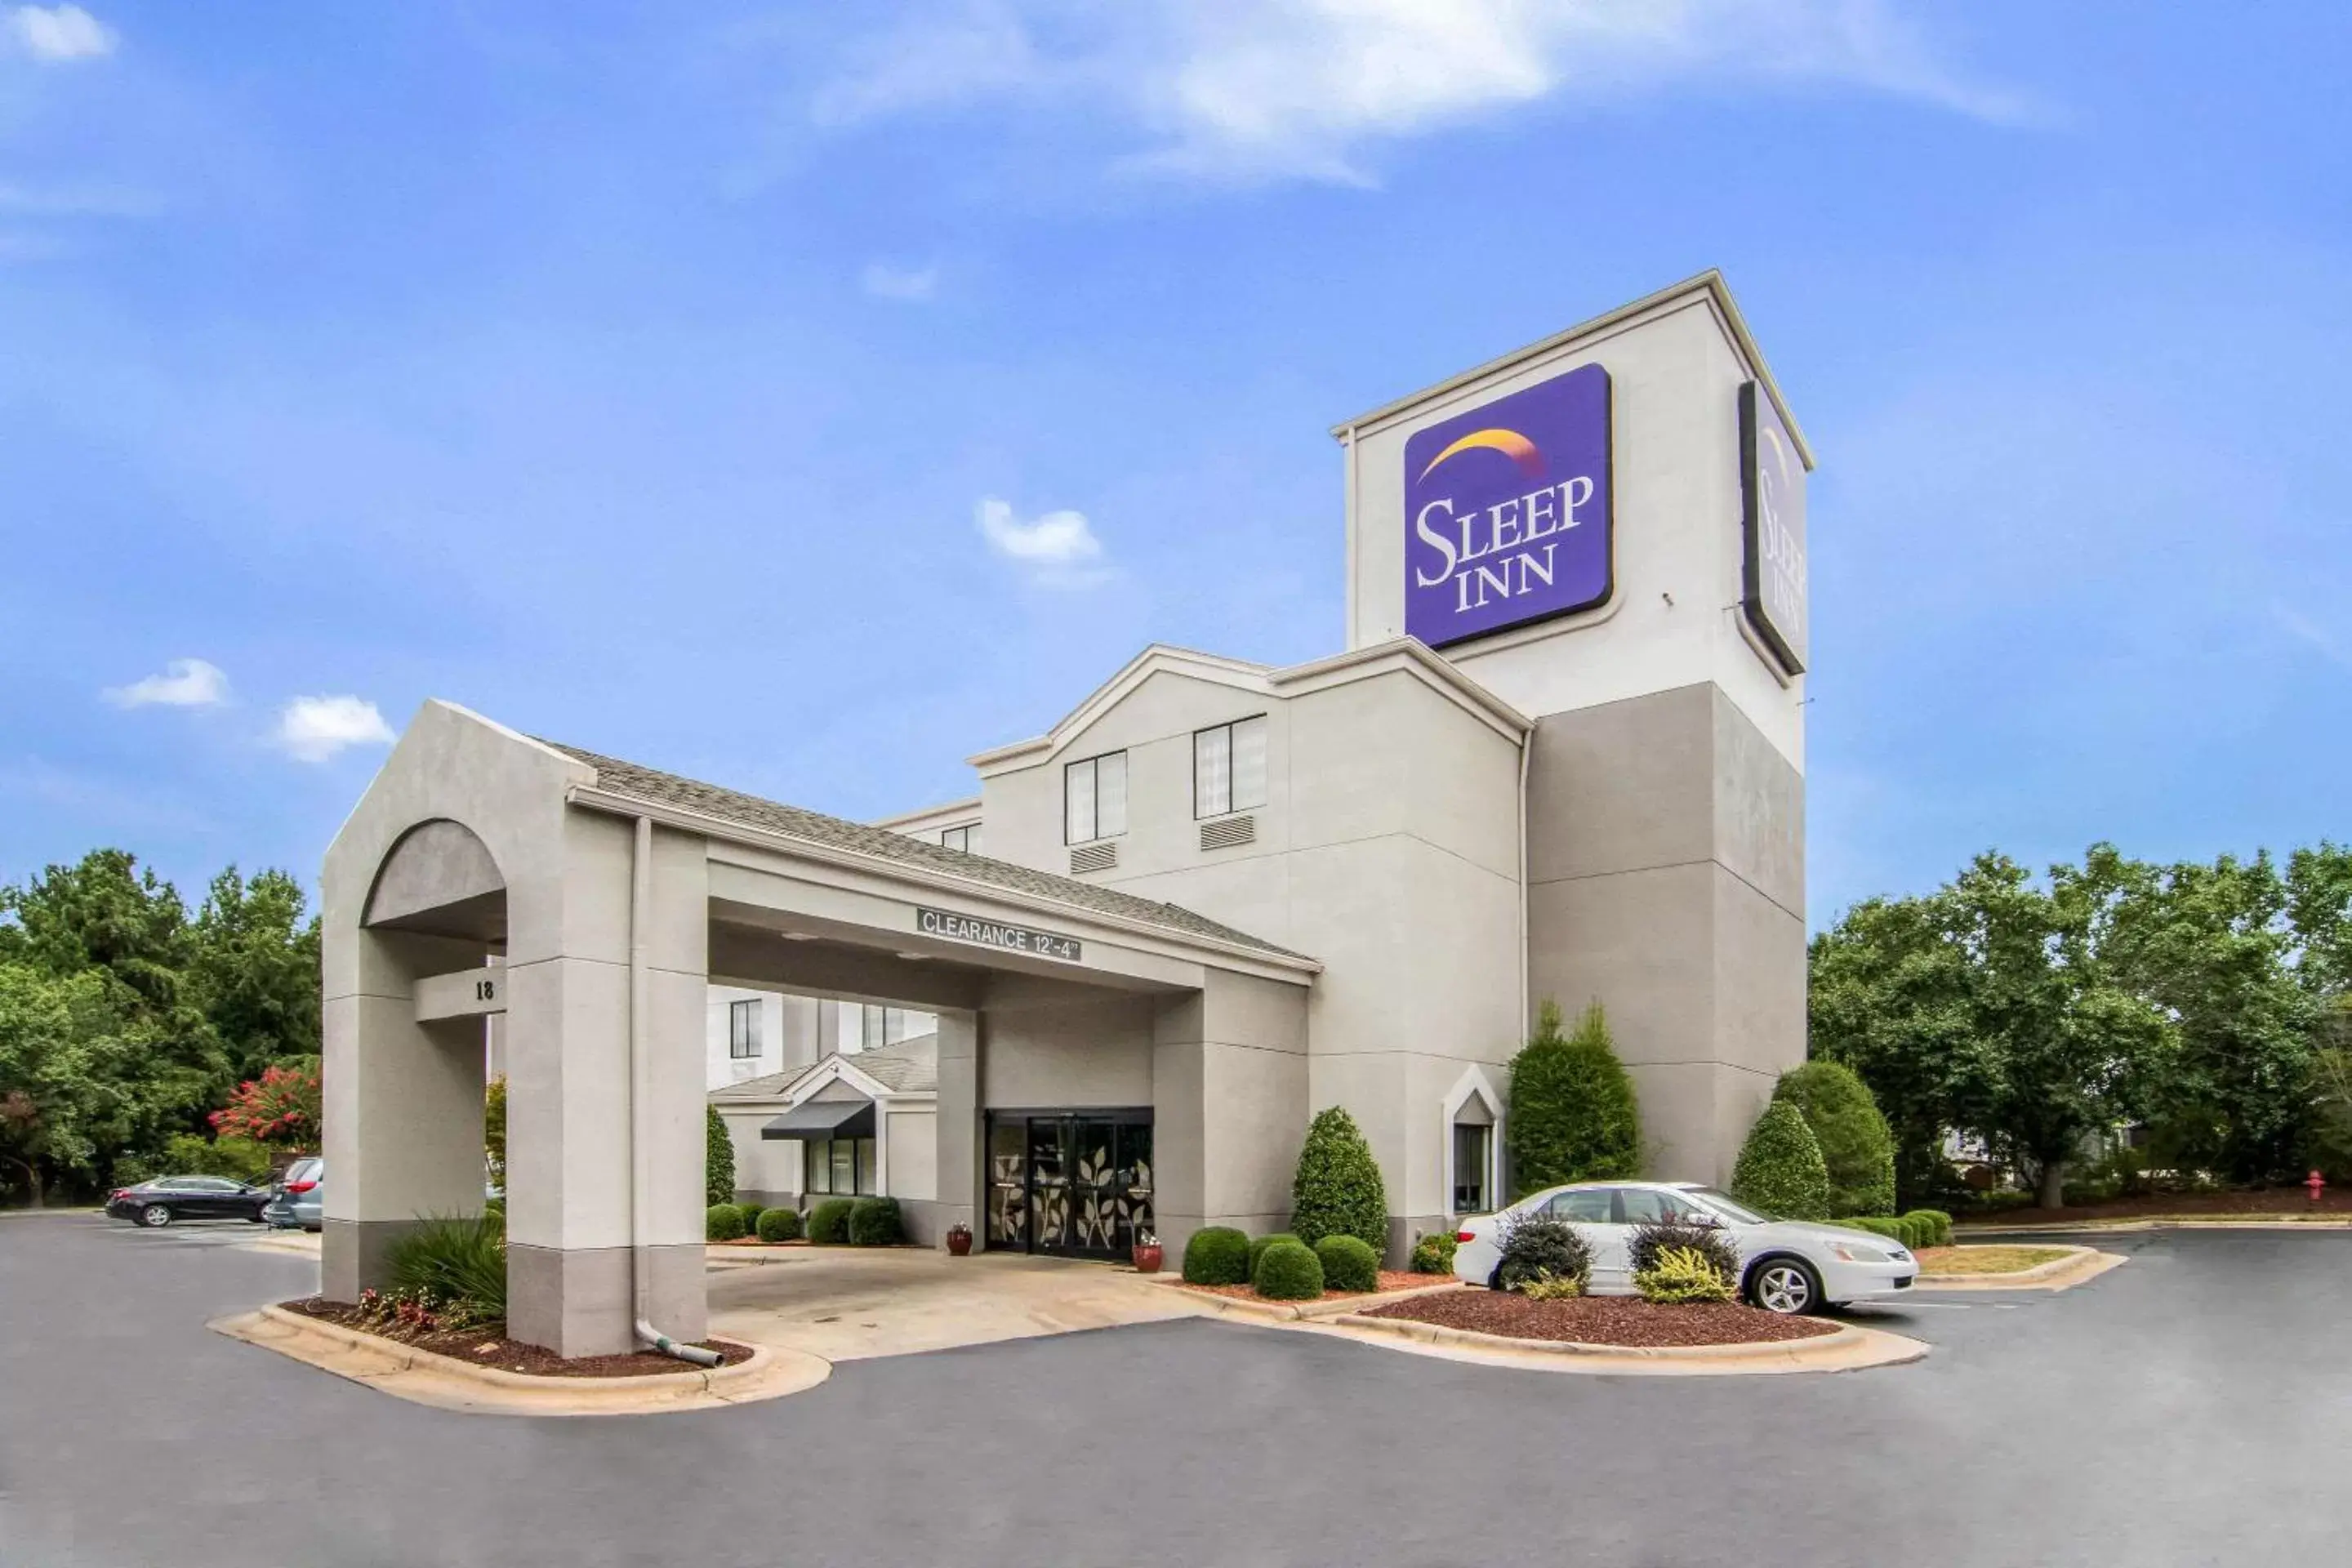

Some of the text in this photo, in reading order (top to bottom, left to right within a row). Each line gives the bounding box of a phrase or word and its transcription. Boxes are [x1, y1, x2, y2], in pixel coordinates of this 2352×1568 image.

[1417, 475, 1594, 588] SLEEP
[1454, 543, 1559, 612] INN
[923, 911, 1026, 949] CLEARANCE
[476, 981, 493, 1000] 18
